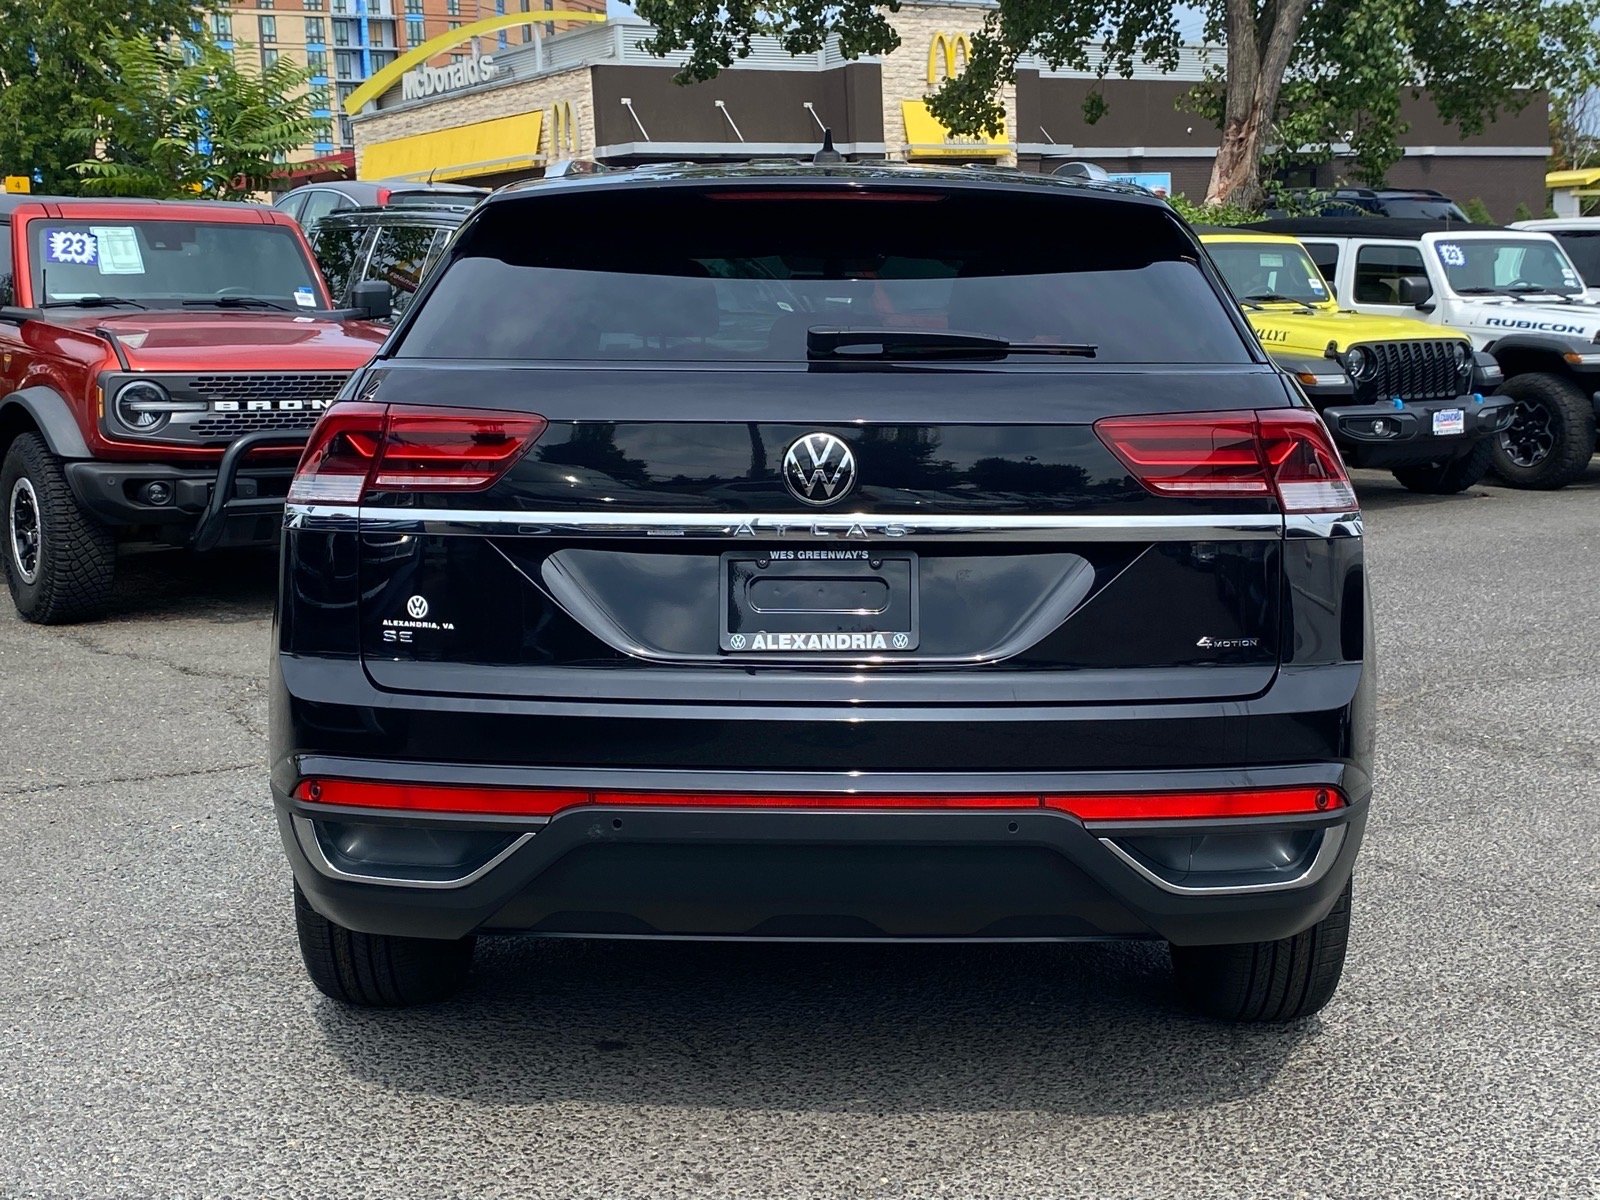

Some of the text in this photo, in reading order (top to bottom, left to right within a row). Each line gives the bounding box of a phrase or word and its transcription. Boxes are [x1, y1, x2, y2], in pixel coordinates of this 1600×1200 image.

[402, 55, 494, 101] McDonald's
[60, 237, 87, 256] 23
[1486, 318, 1585, 334] RUBICON
[214, 400, 334, 411] BRON
[733, 523, 909, 537] ATLAS
[769, 551, 869, 560] WES GREENWAY'S
[382, 619, 441, 630] ALEXANDRIA,
[383, 630, 413, 643] SE
[752, 634, 887, 650] ALEXANDRIA
